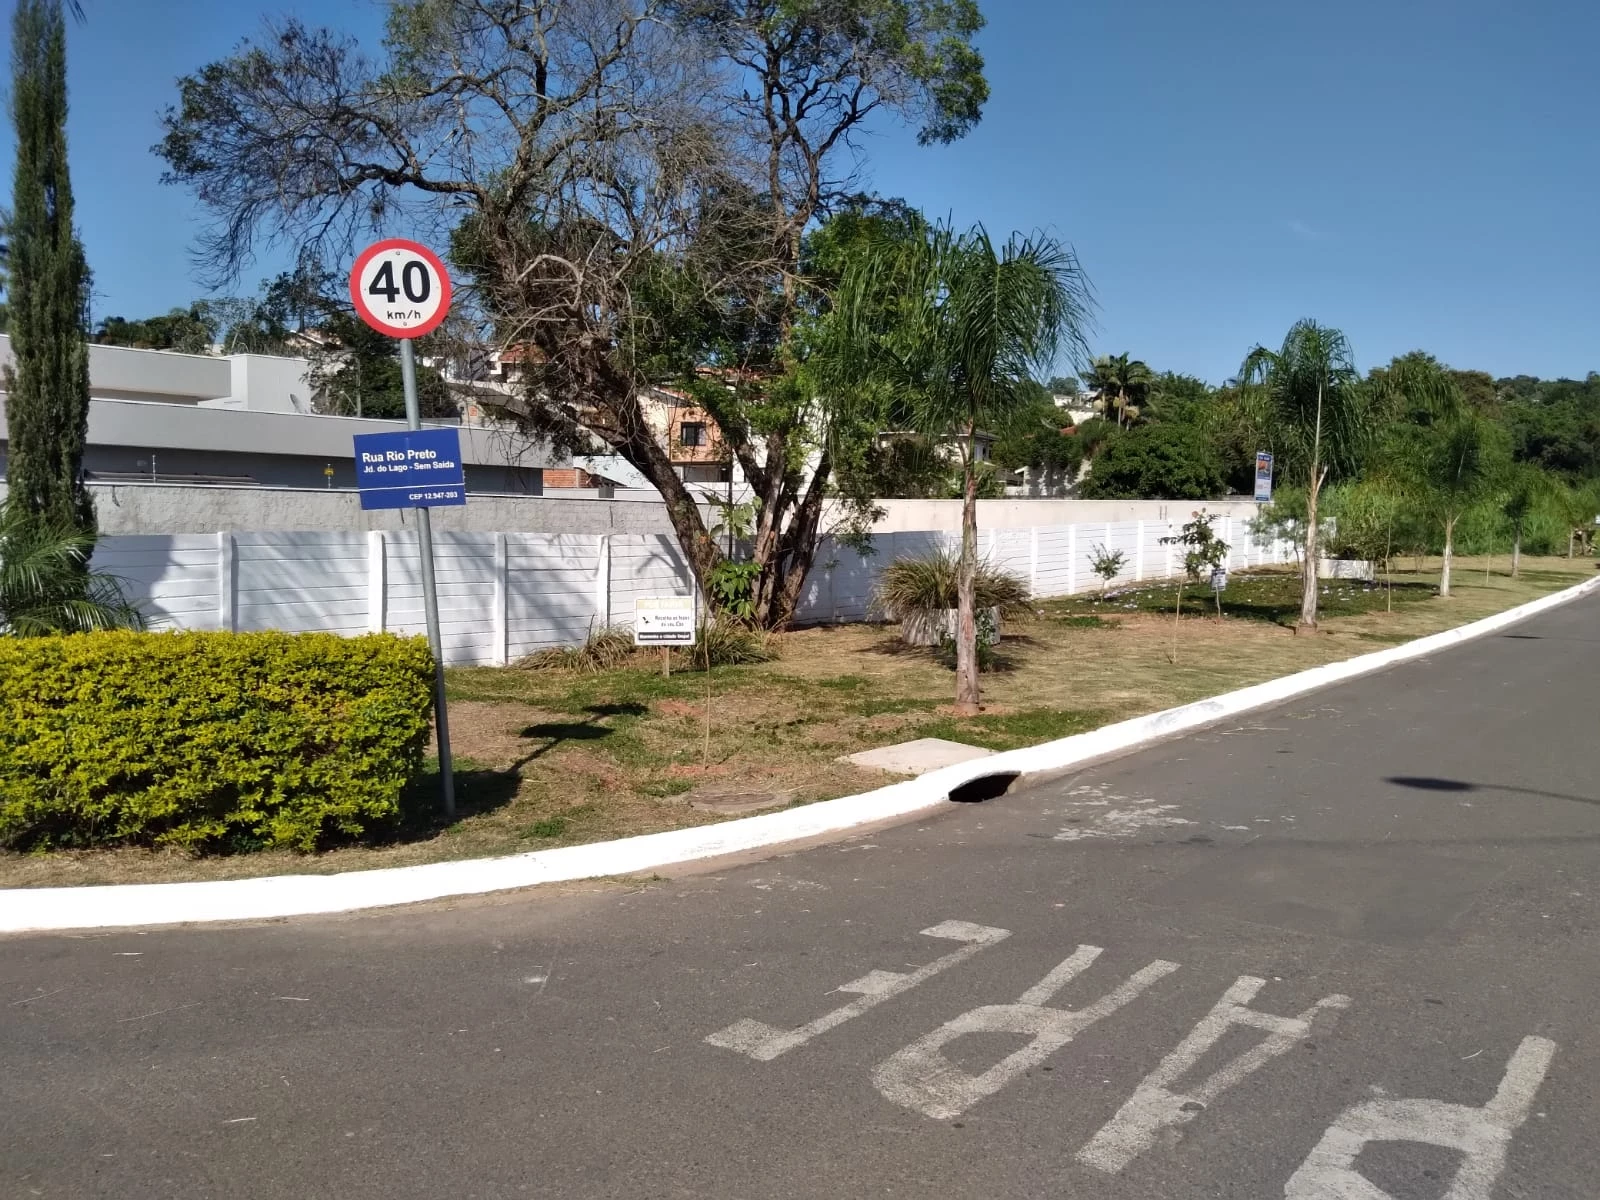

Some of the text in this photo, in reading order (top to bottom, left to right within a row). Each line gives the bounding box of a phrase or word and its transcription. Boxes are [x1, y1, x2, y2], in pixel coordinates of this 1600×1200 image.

[369, 260, 431, 304] 40
[387, 309, 421, 319] km/h
[362, 449, 437, 462] Rua Rio Preto
[363, 465, 376, 473] Jd.
[377, 464, 388, 472] do
[388, 463, 408, 473] Lago
[413, 461, 432, 470] Sem
